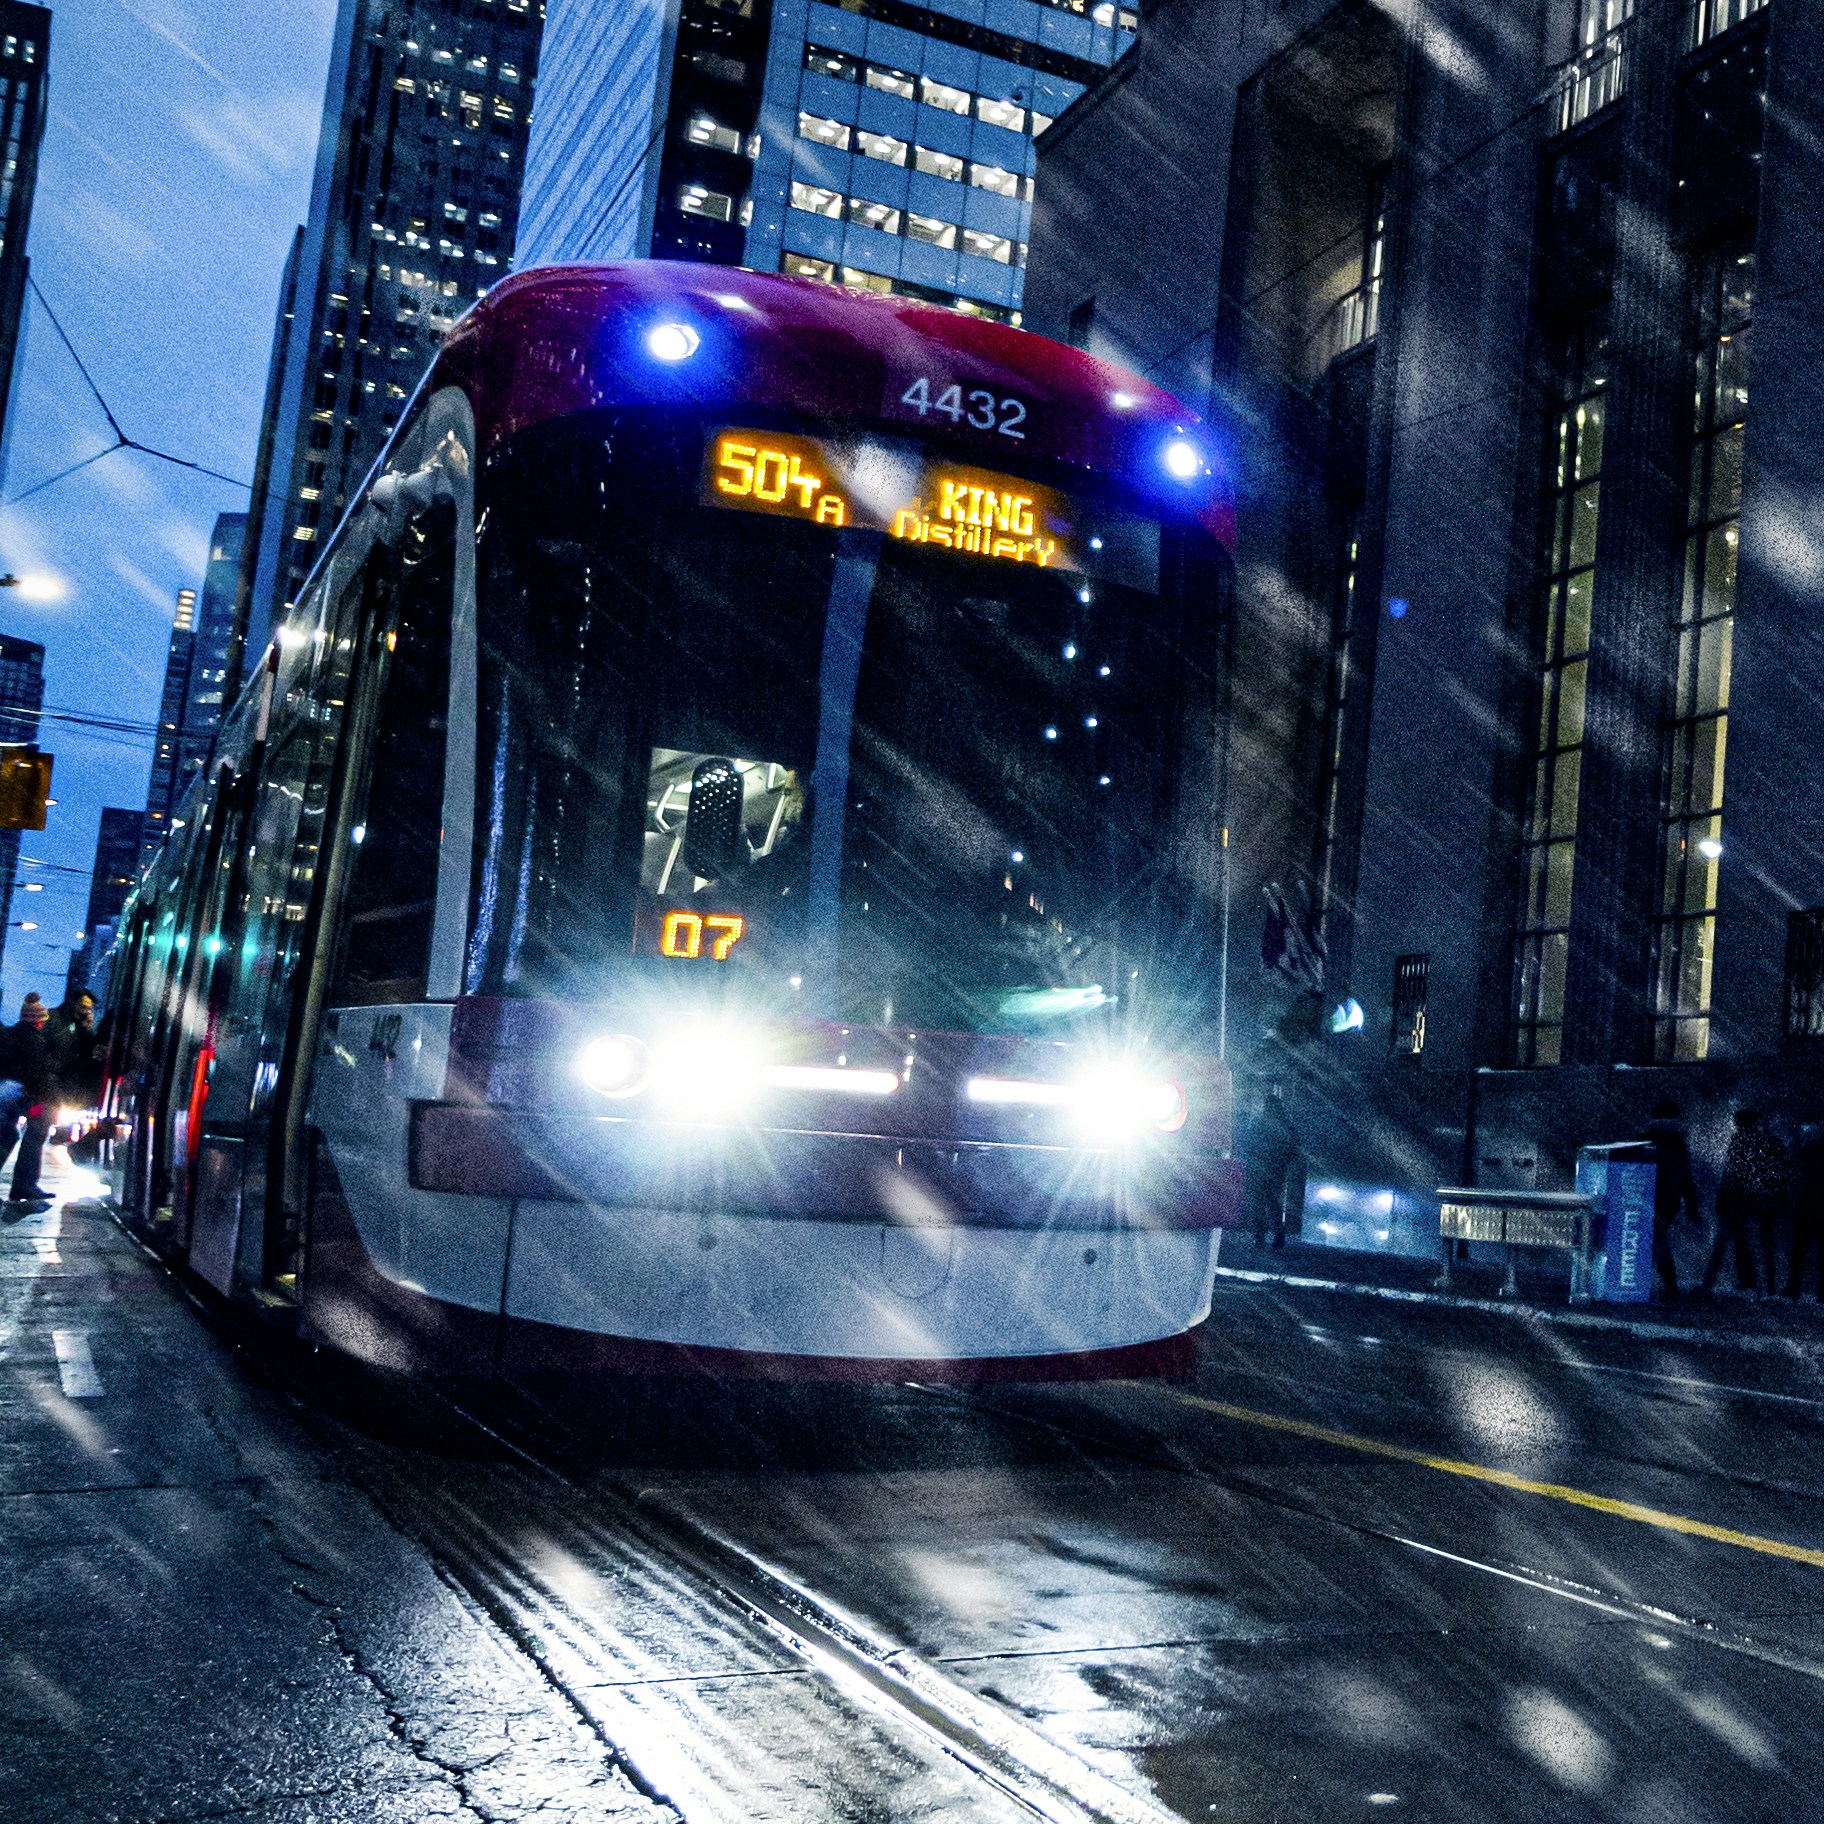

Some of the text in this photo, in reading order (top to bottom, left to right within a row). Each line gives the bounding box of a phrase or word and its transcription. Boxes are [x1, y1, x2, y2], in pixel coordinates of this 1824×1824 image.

[901, 377, 1027, 440] 4432
[940, 478, 1034, 536] KING
[660, 909, 745, 962] 07
